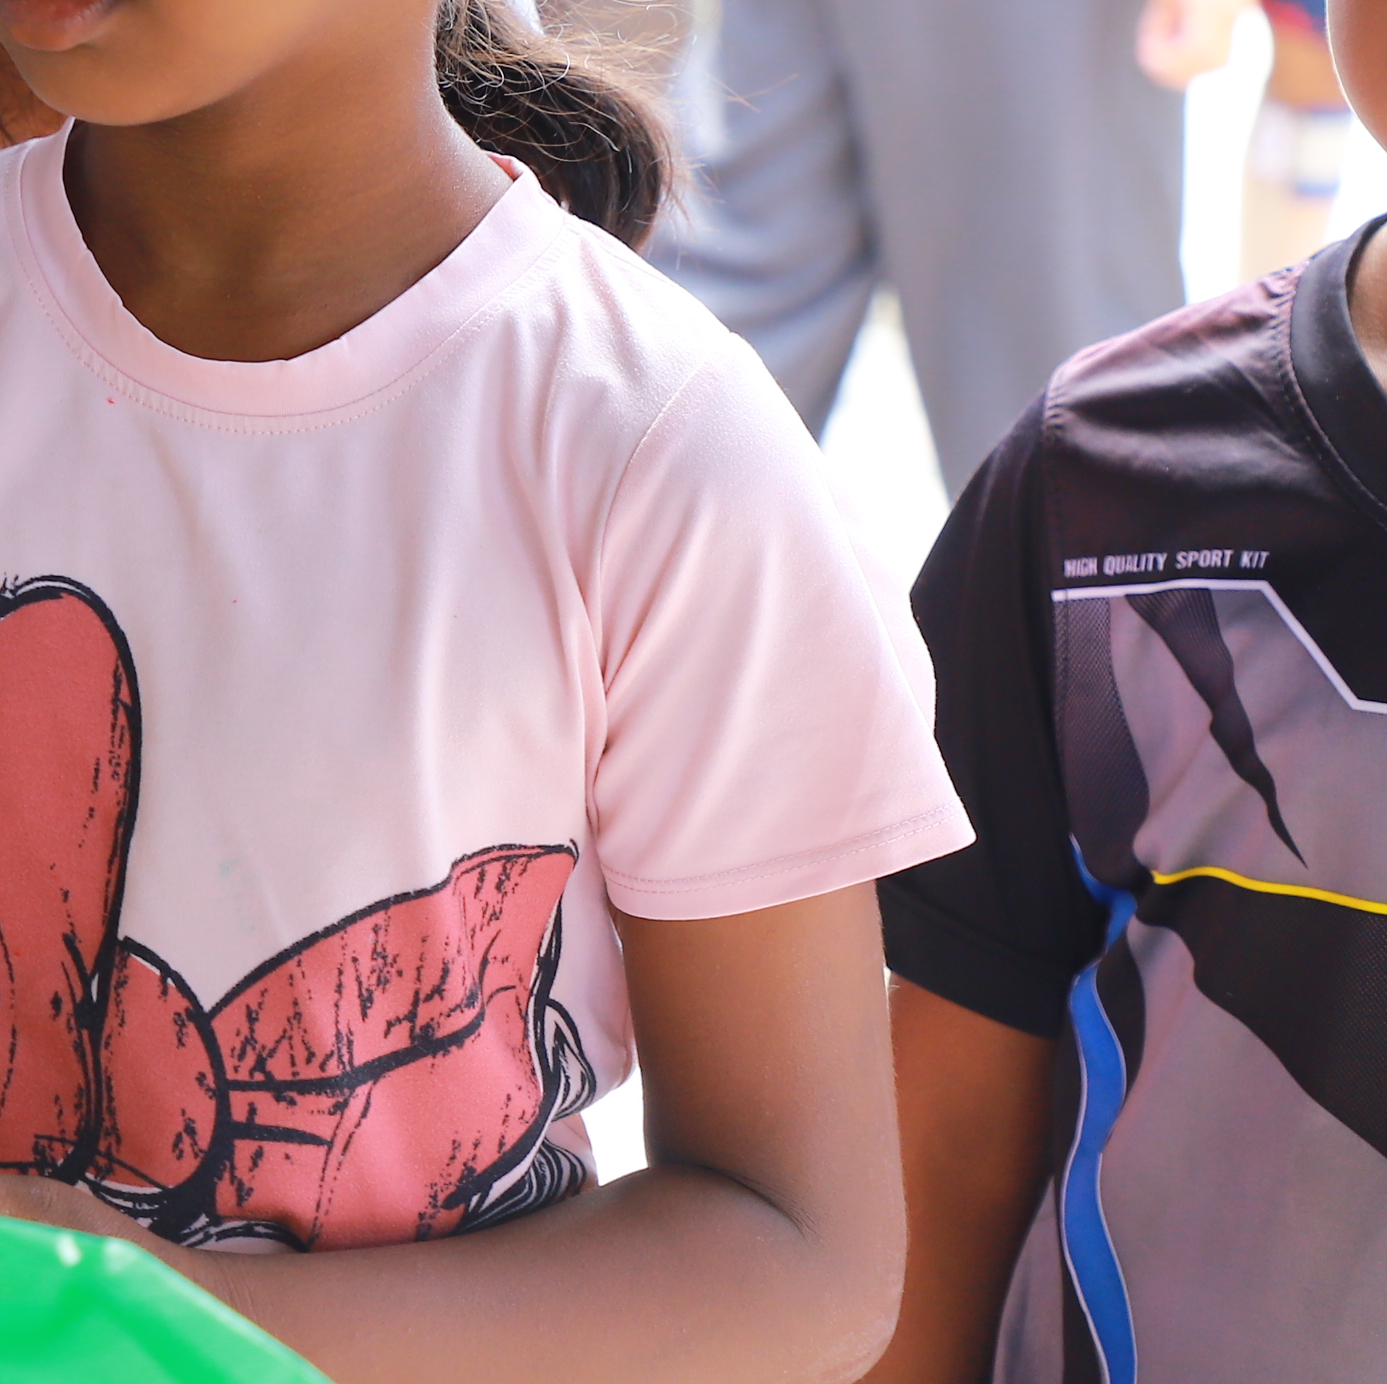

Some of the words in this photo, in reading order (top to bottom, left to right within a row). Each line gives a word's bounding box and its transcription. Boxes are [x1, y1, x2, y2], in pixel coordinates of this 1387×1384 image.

[1064, 557, 1098, 578] HIGH
[1103, 552, 1167, 576] QUALITY
[1175, 549, 1234, 570] SPORT
[1239, 550, 1270, 569] KIT
